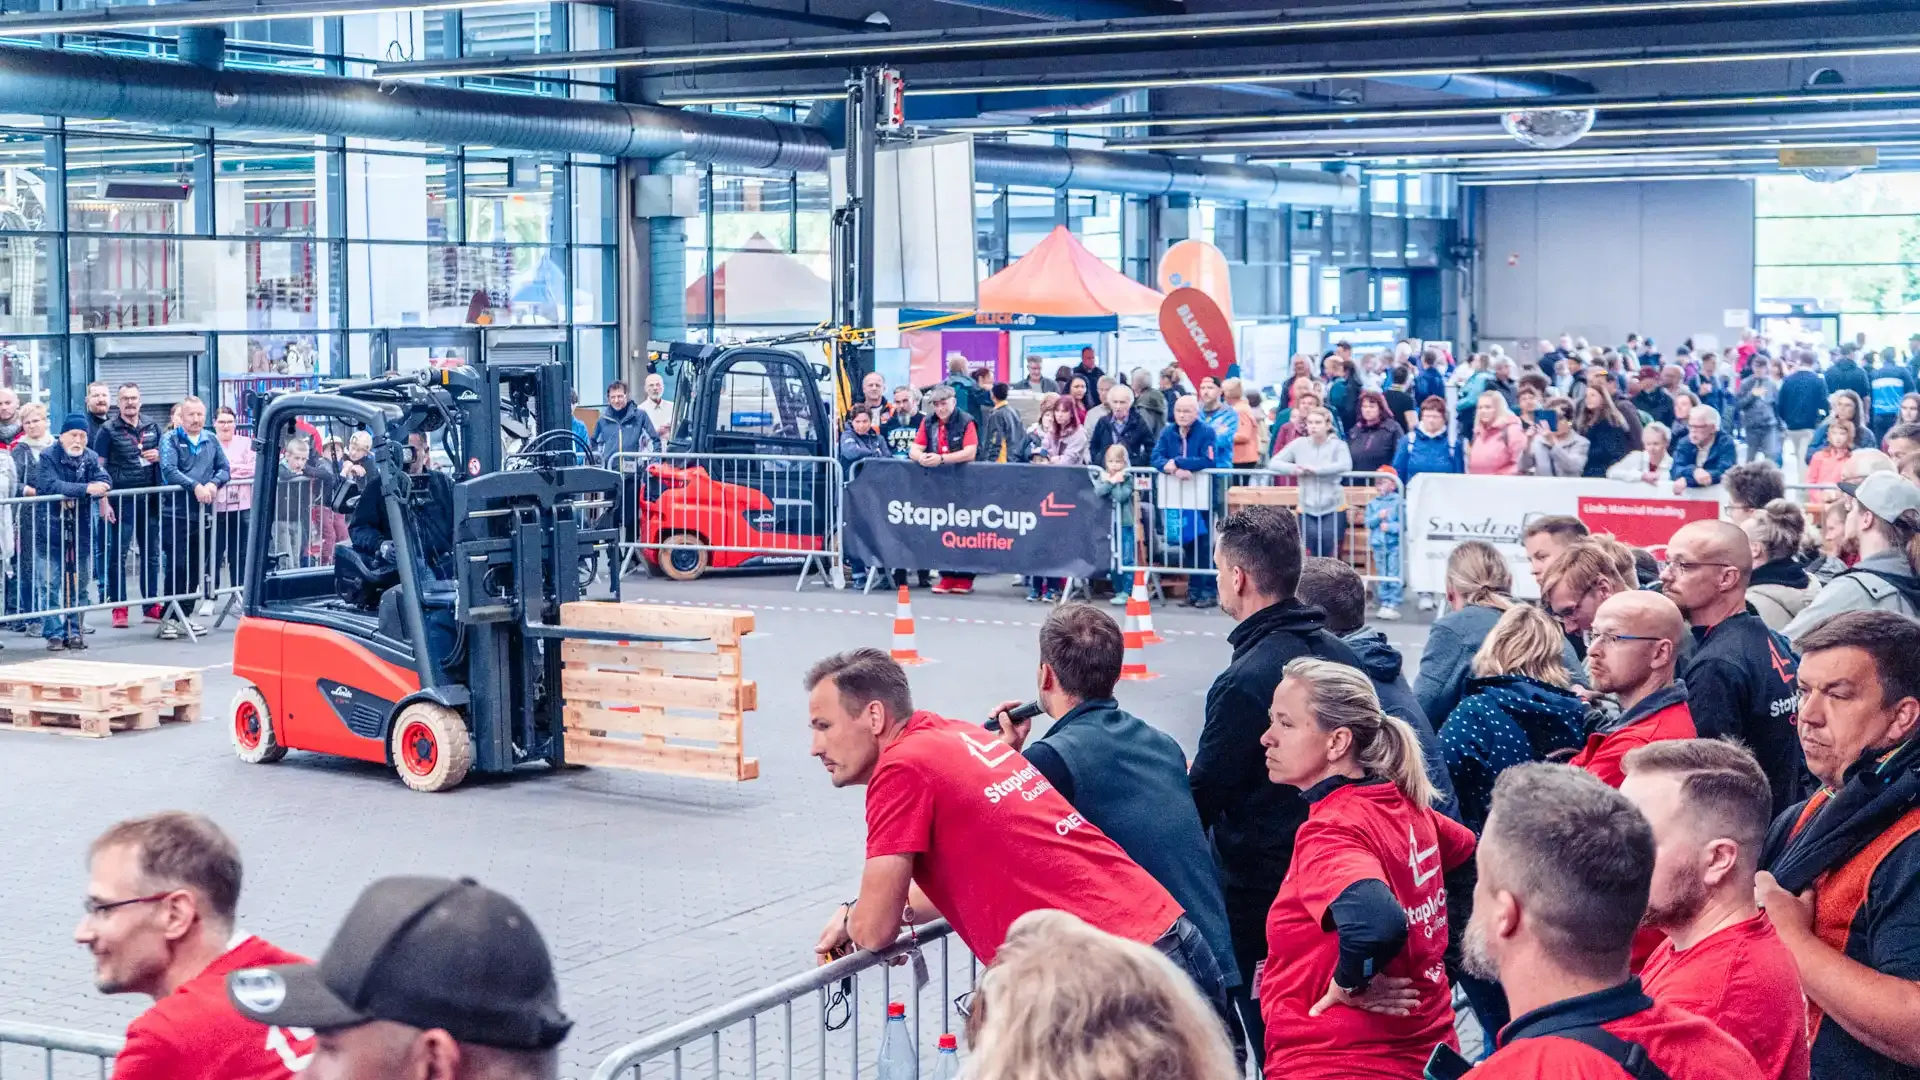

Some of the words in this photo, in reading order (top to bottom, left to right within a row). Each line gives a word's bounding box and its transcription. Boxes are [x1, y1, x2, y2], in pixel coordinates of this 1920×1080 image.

[1176, 304, 1219, 369] BLICK.de
[888, 500, 1037, 536] StaplerCup
[1583, 503, 1607, 514] Linde
[1608, 504, 1646, 515] Material
[1646, 505, 1686, 520] Handling
[942, 531, 1014, 550] Qualifier
[331, 686, 352, 698] Linde
